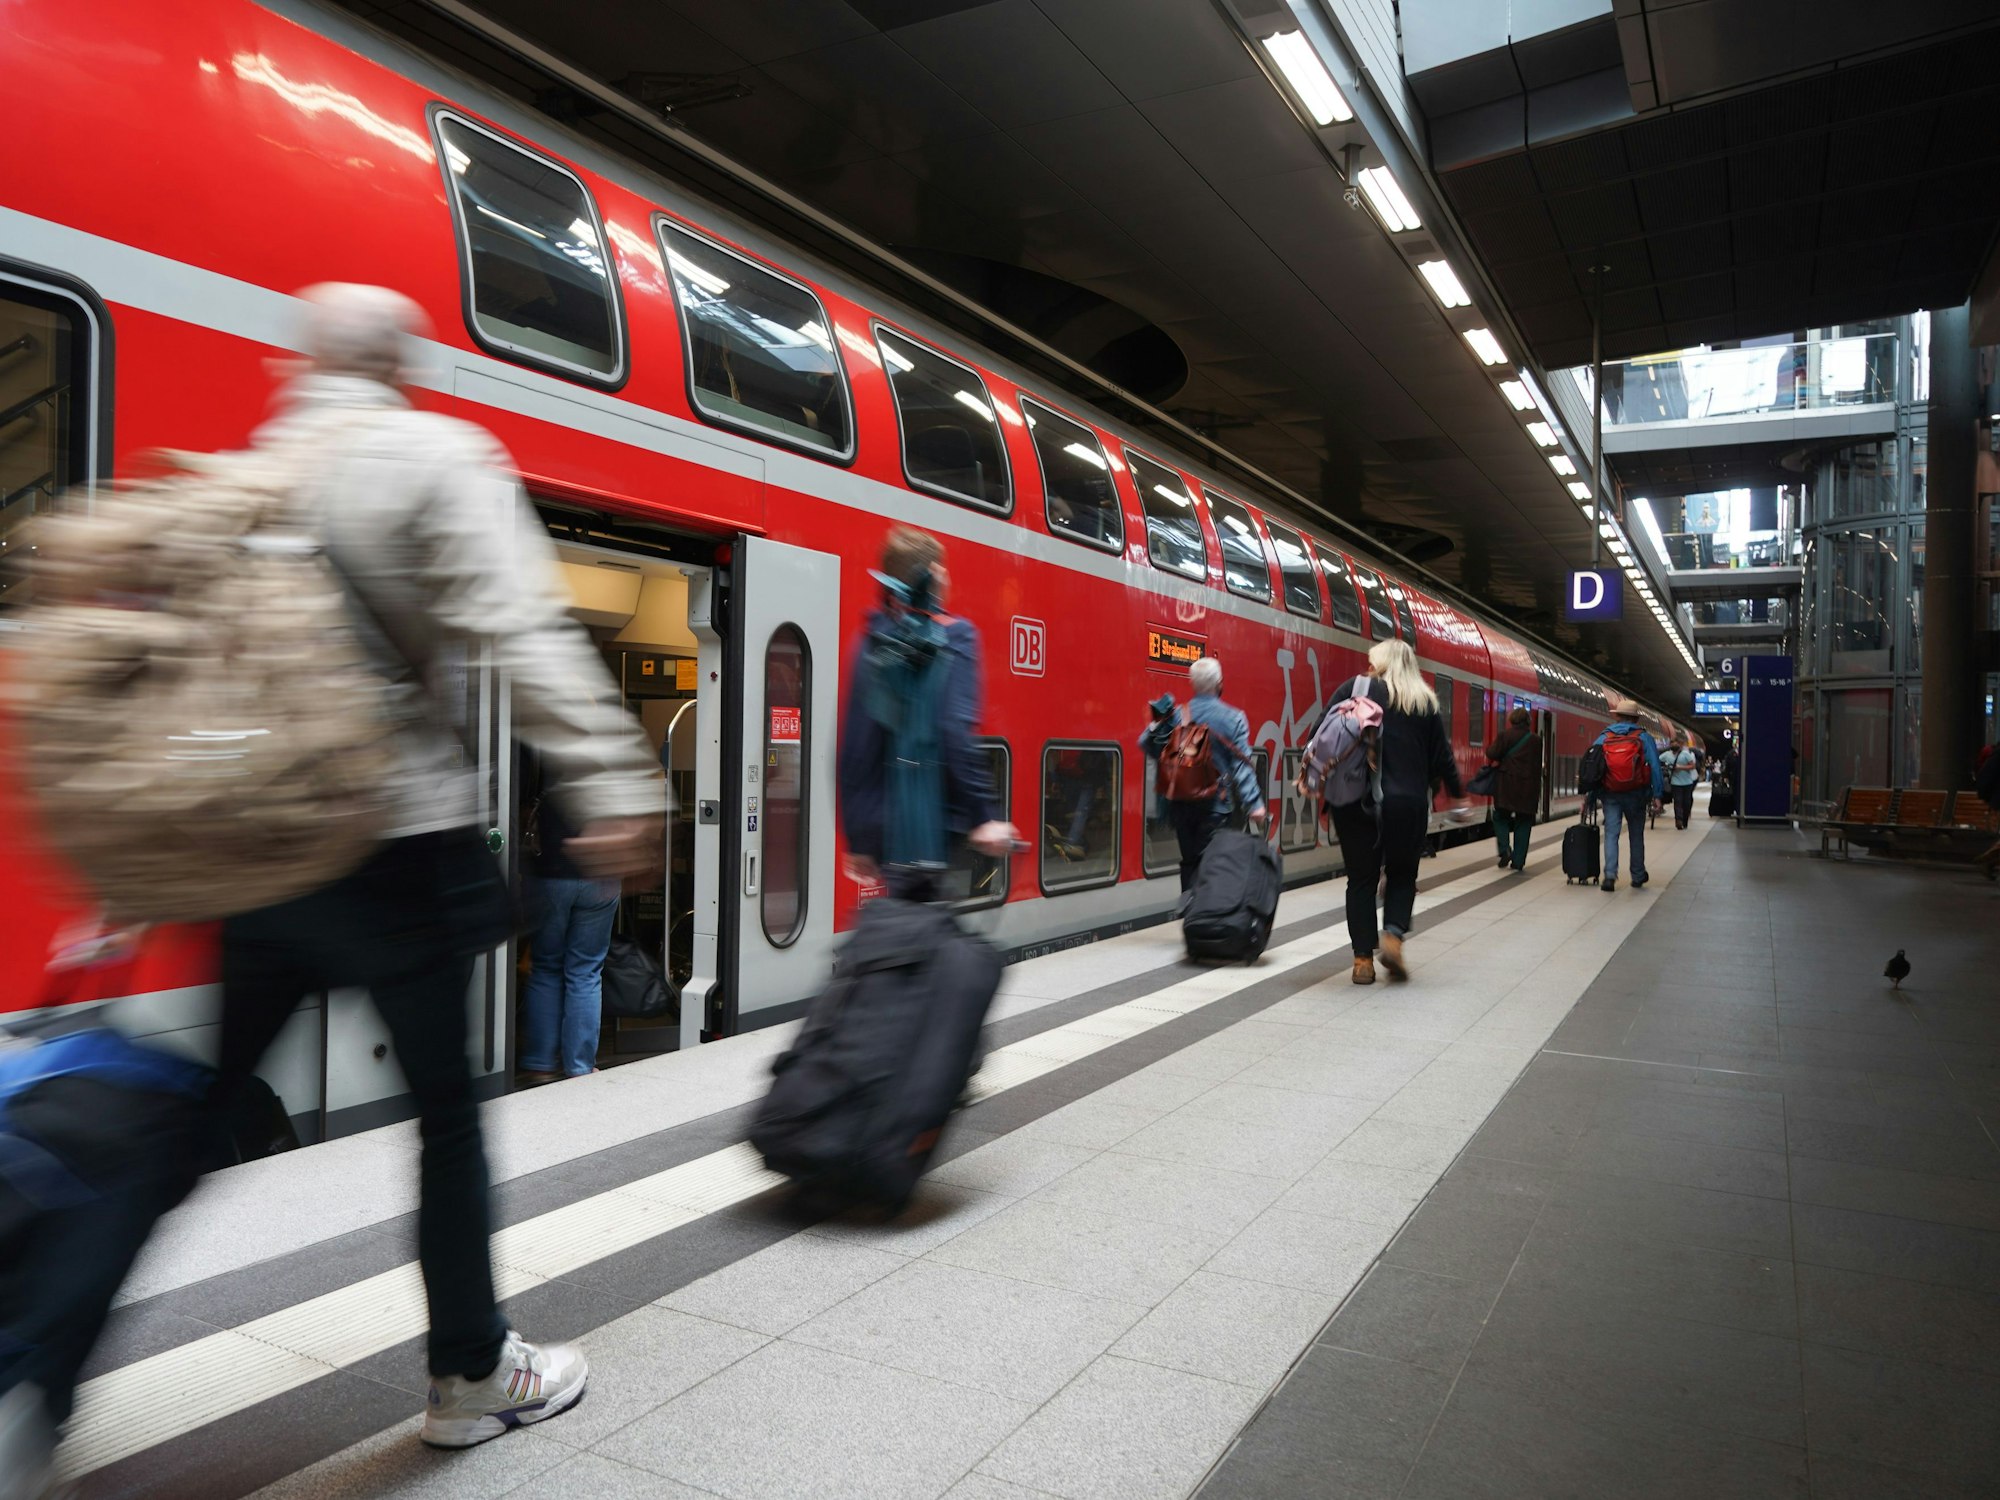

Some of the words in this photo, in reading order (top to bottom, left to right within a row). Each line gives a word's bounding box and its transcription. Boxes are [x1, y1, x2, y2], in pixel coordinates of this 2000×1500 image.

[1573, 571, 1604, 620] D
[1016, 626, 1041, 666] DB
[1721, 658, 1732, 673] 6
[1723, 729, 1732, 739] C
